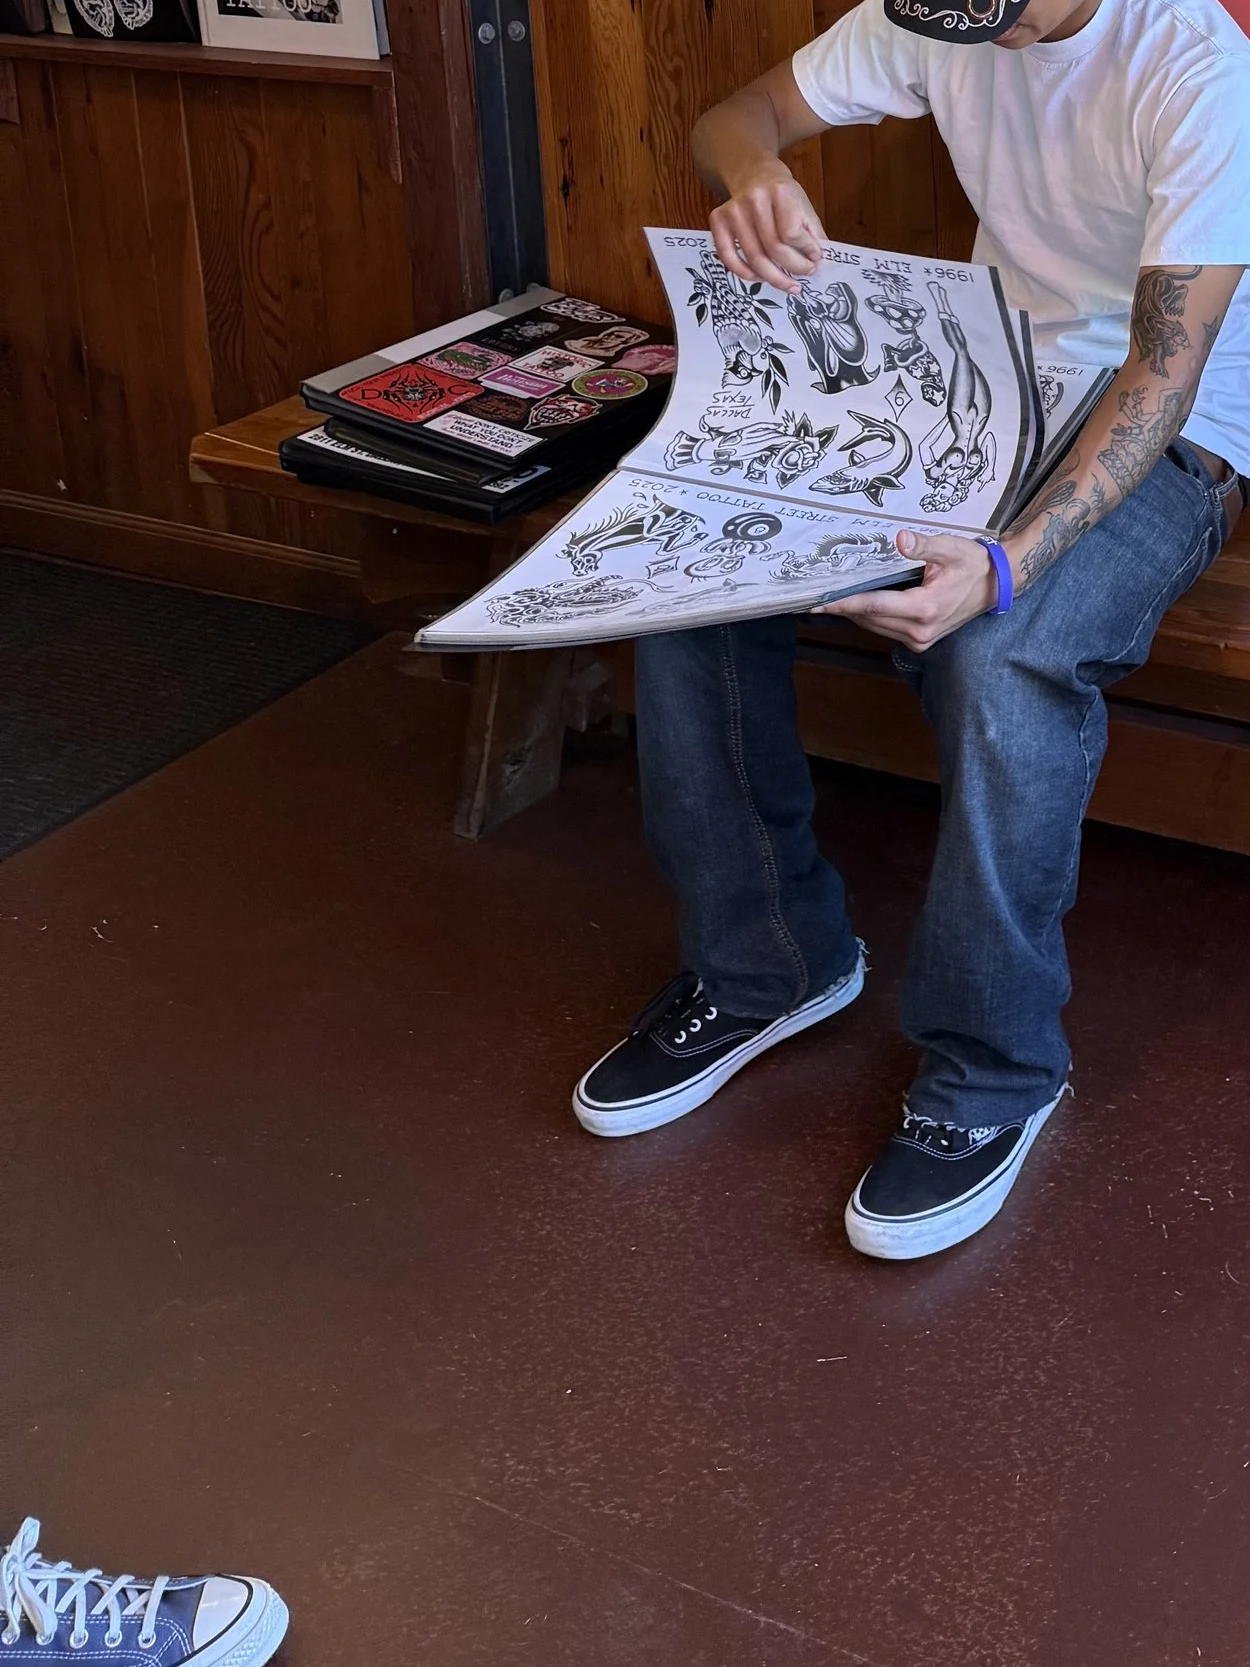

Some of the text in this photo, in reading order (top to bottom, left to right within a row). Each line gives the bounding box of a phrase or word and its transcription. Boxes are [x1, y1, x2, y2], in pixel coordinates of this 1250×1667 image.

[664, 236, 708, 249] 2025
[820, 247, 861, 267] STRE
[874, 258, 913, 275] ELM
[712, 390, 752, 407] TEXAS
[697, 492, 767, 512] TATTOO
[774, 507, 840, 524] STREET
